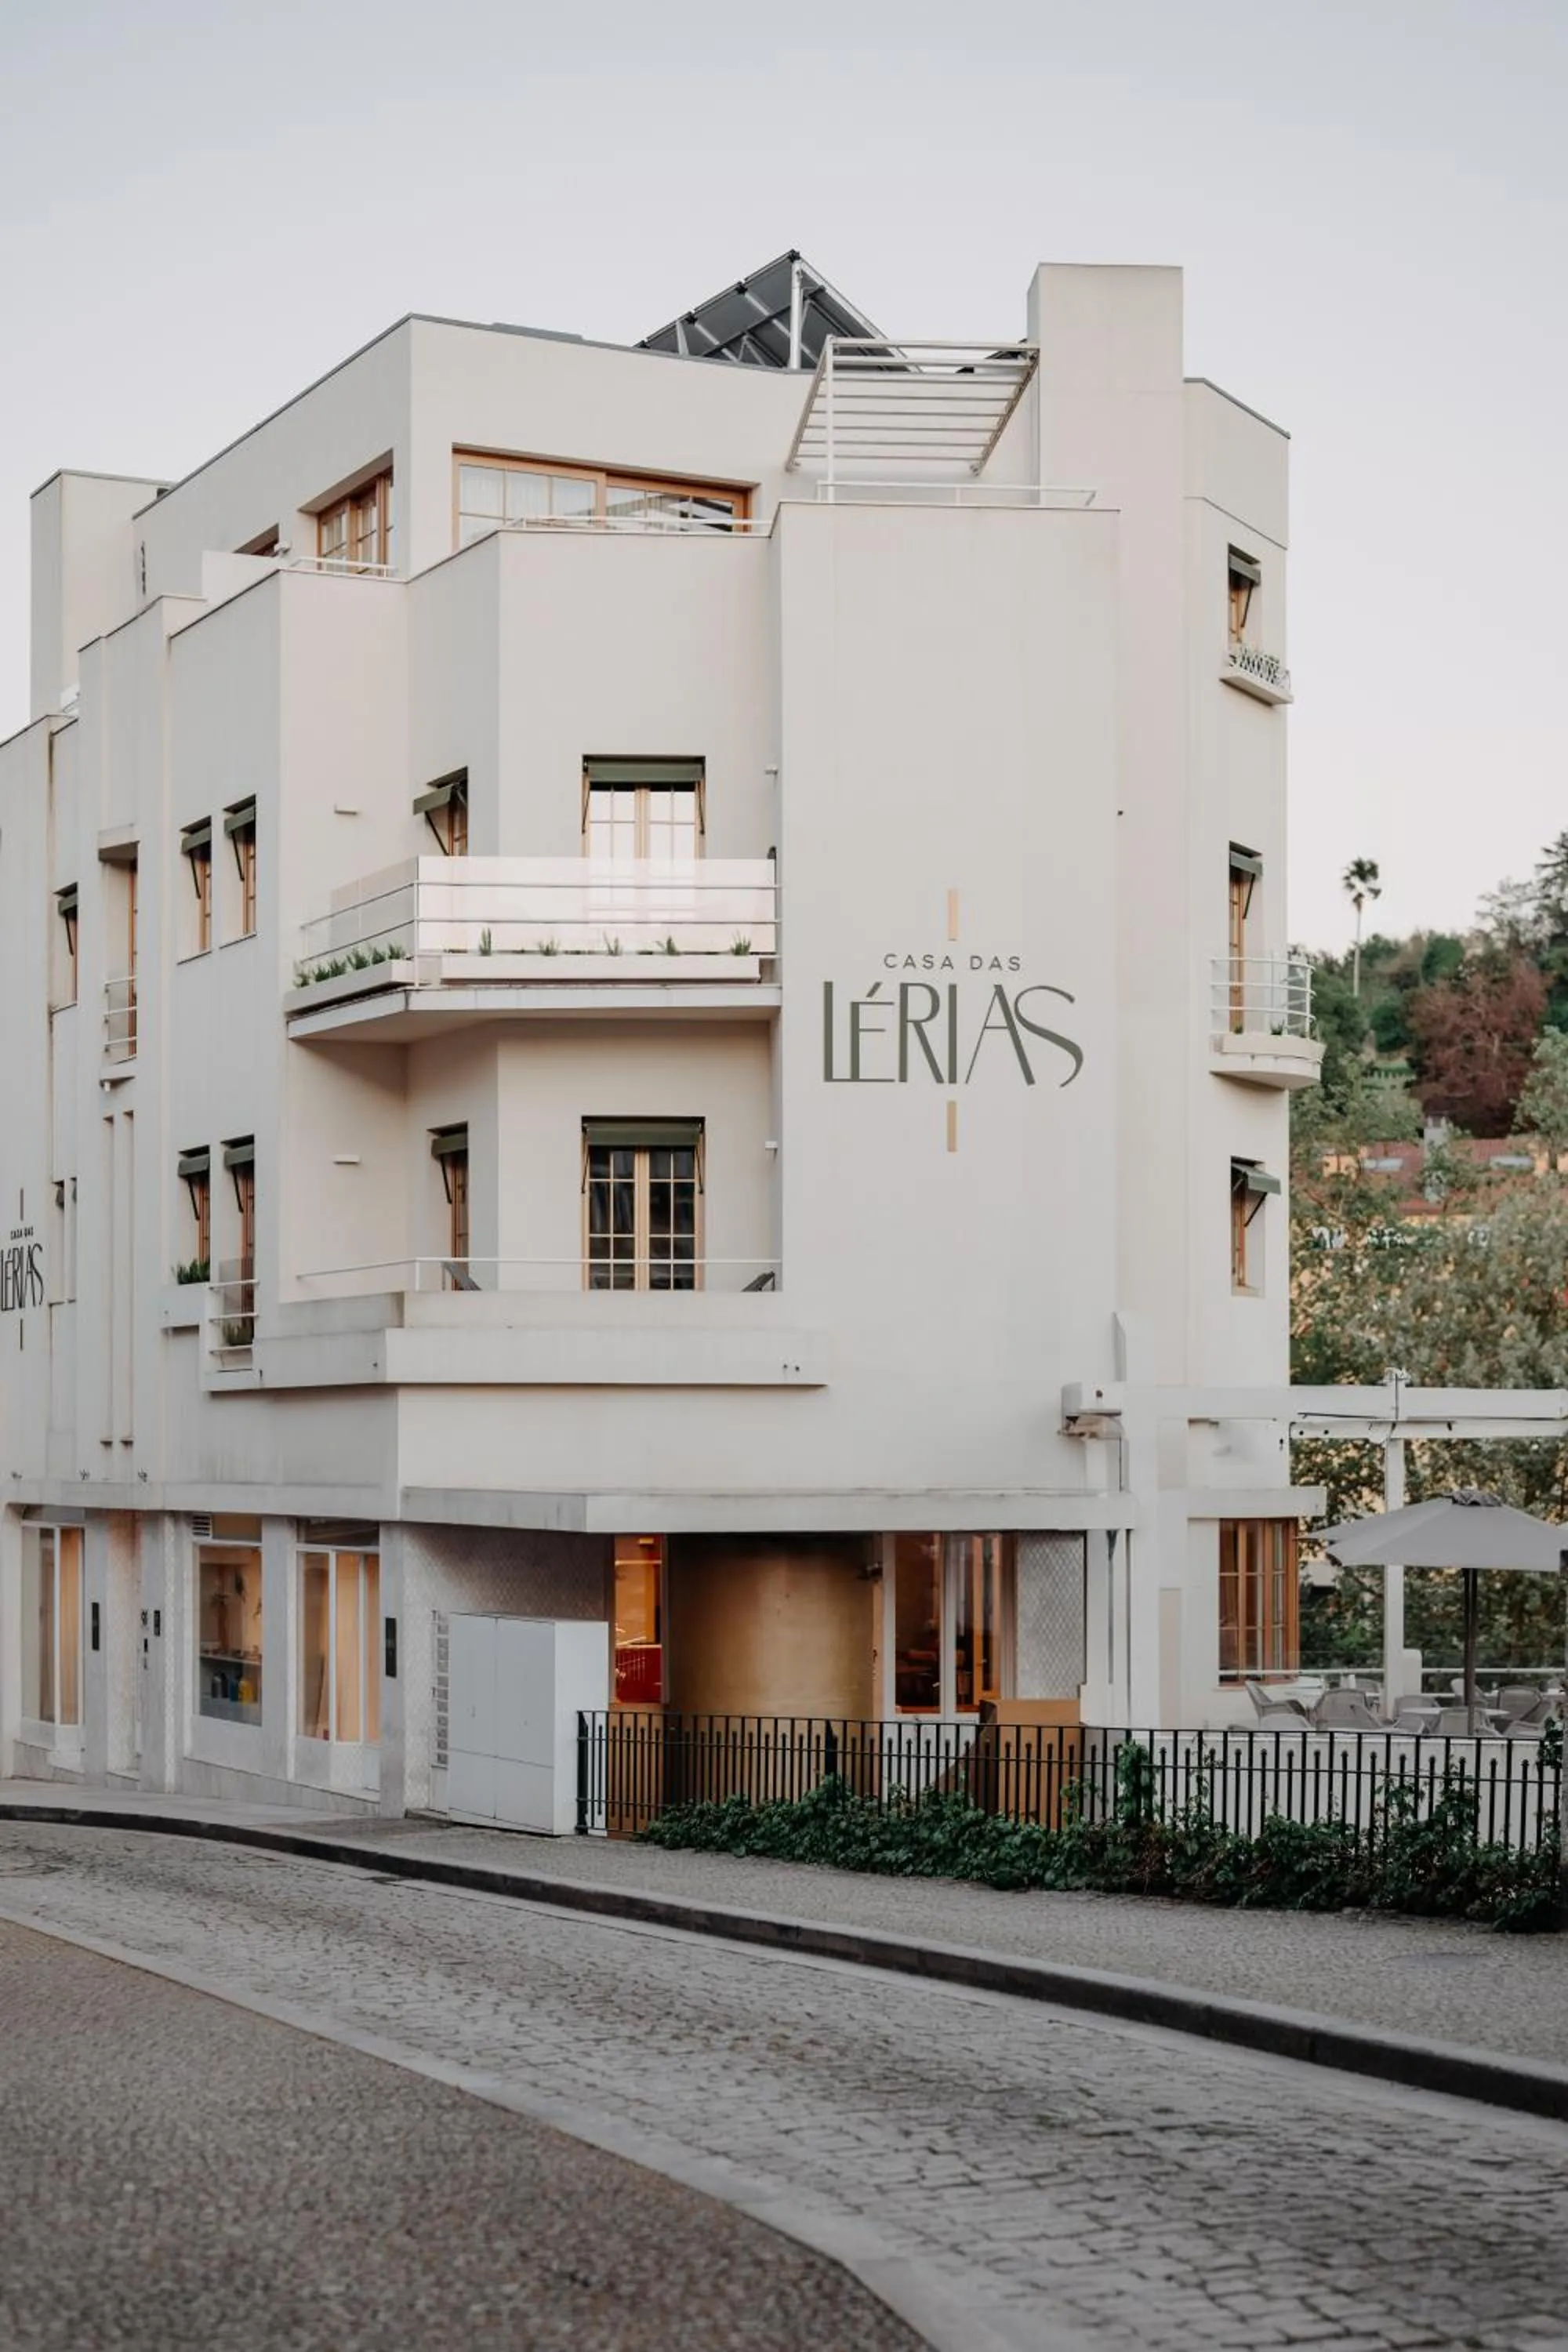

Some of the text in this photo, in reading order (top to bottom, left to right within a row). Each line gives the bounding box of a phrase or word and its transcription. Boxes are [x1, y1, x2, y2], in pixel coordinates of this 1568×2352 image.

[883, 953, 1021, 971] CASA DAS
[823, 981, 1083, 1087] LÉRIAS
[0, 1243, 44, 1311] LÉRIAS
